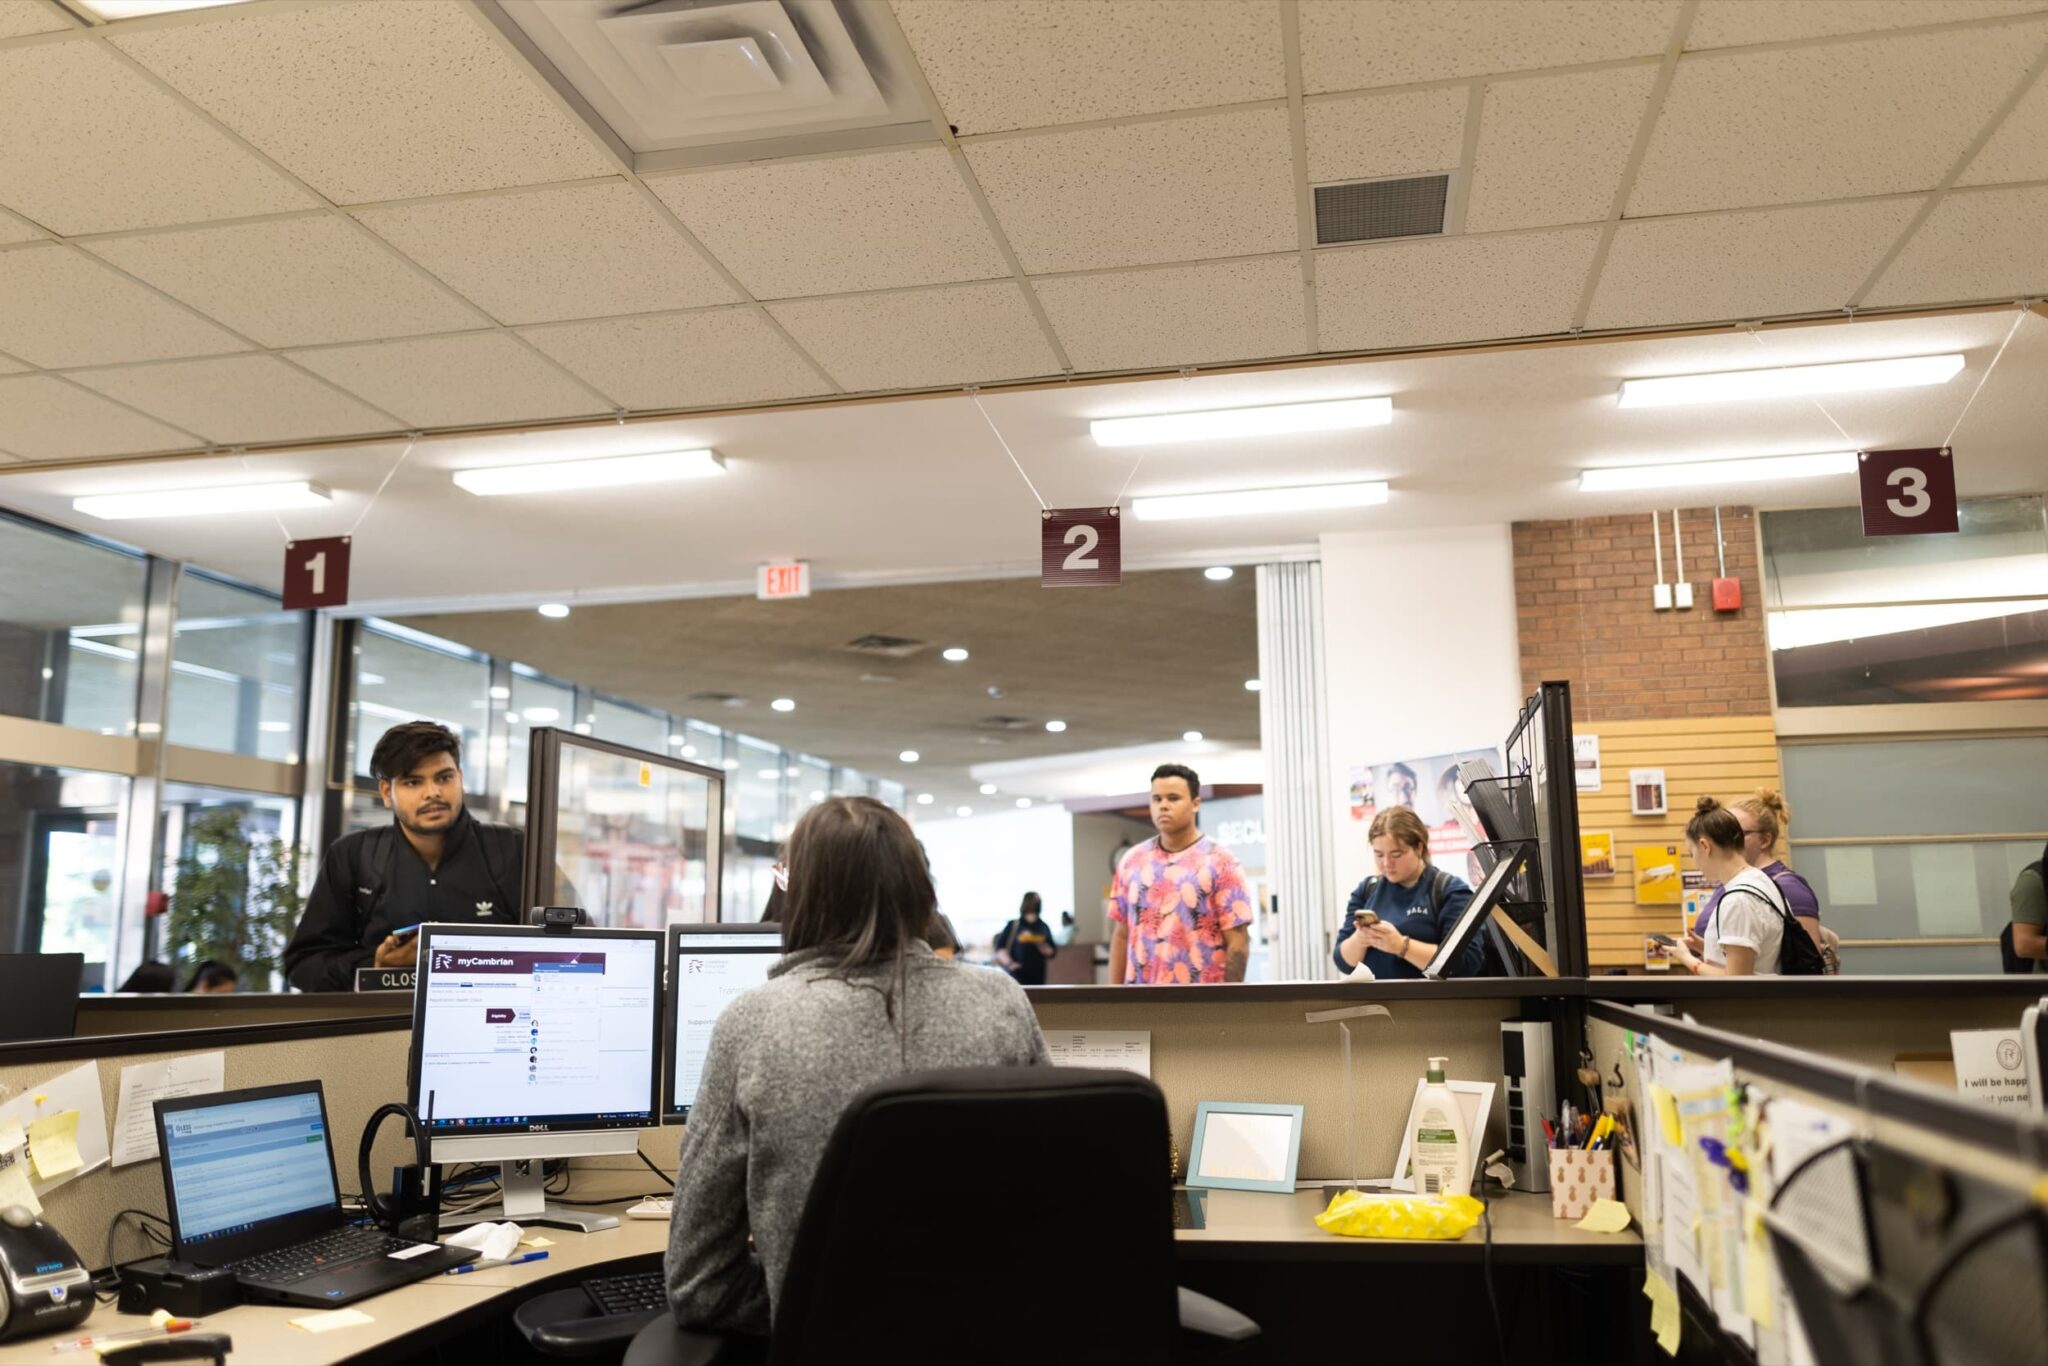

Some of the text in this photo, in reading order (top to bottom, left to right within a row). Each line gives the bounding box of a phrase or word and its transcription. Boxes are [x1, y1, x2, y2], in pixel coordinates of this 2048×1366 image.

[1886, 467, 1931, 518] 3
[1062, 524, 1099, 570] 2
[304, 551, 326, 595] 1
[767, 566, 801, 595] EXIT
[457, 957, 514, 967] myCambrian
[1971, 1077, 1988, 1088] will
[1990, 1077, 2002, 1087] be
[1997, 1094, 2014, 1105] you
